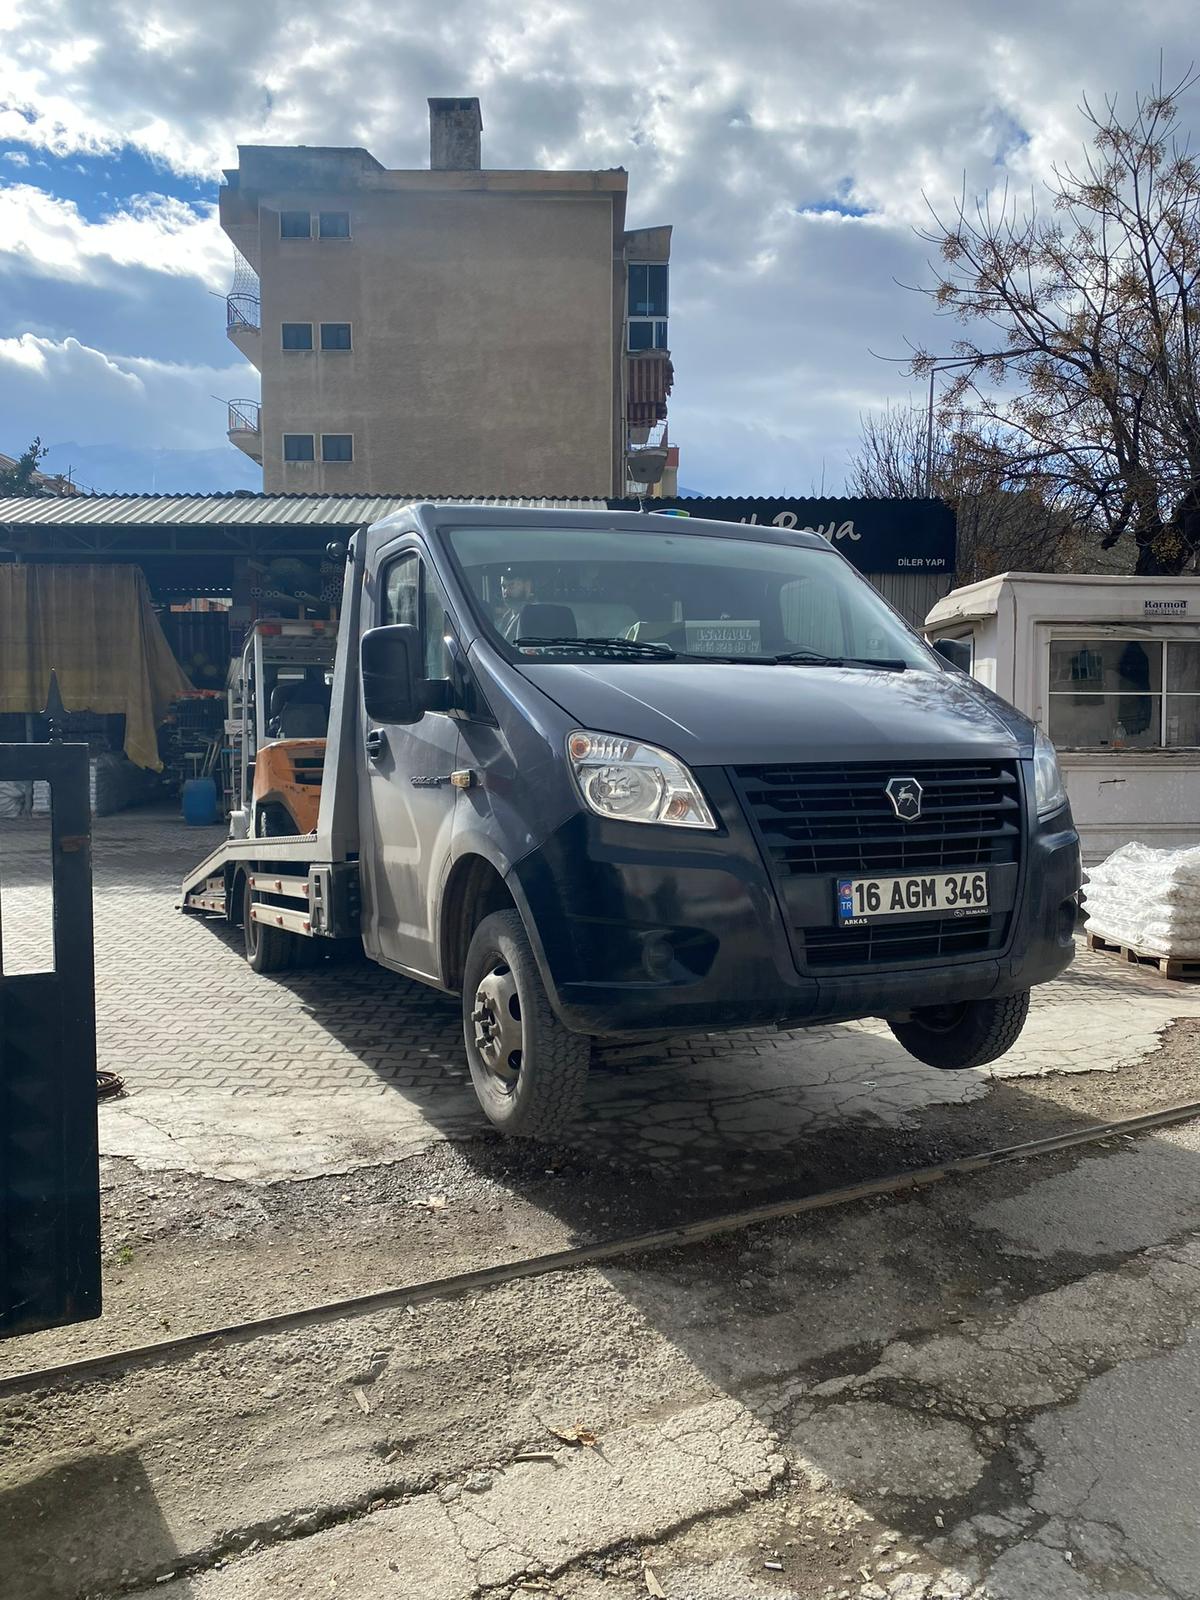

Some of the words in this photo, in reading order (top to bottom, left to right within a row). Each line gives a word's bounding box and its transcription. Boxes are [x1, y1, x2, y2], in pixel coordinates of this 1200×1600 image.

[898, 558, 923, 567] DİLER
[926, 558, 945, 567] YAPI
[1145, 600, 1187, 608] Karmod
[855, 882, 881, 912] 16
[889, 878, 937, 911] AGM
[945, 875, 985, 906] 346
[841, 901, 852, 910] TR
[844, 917, 868, 926] ARKAS
